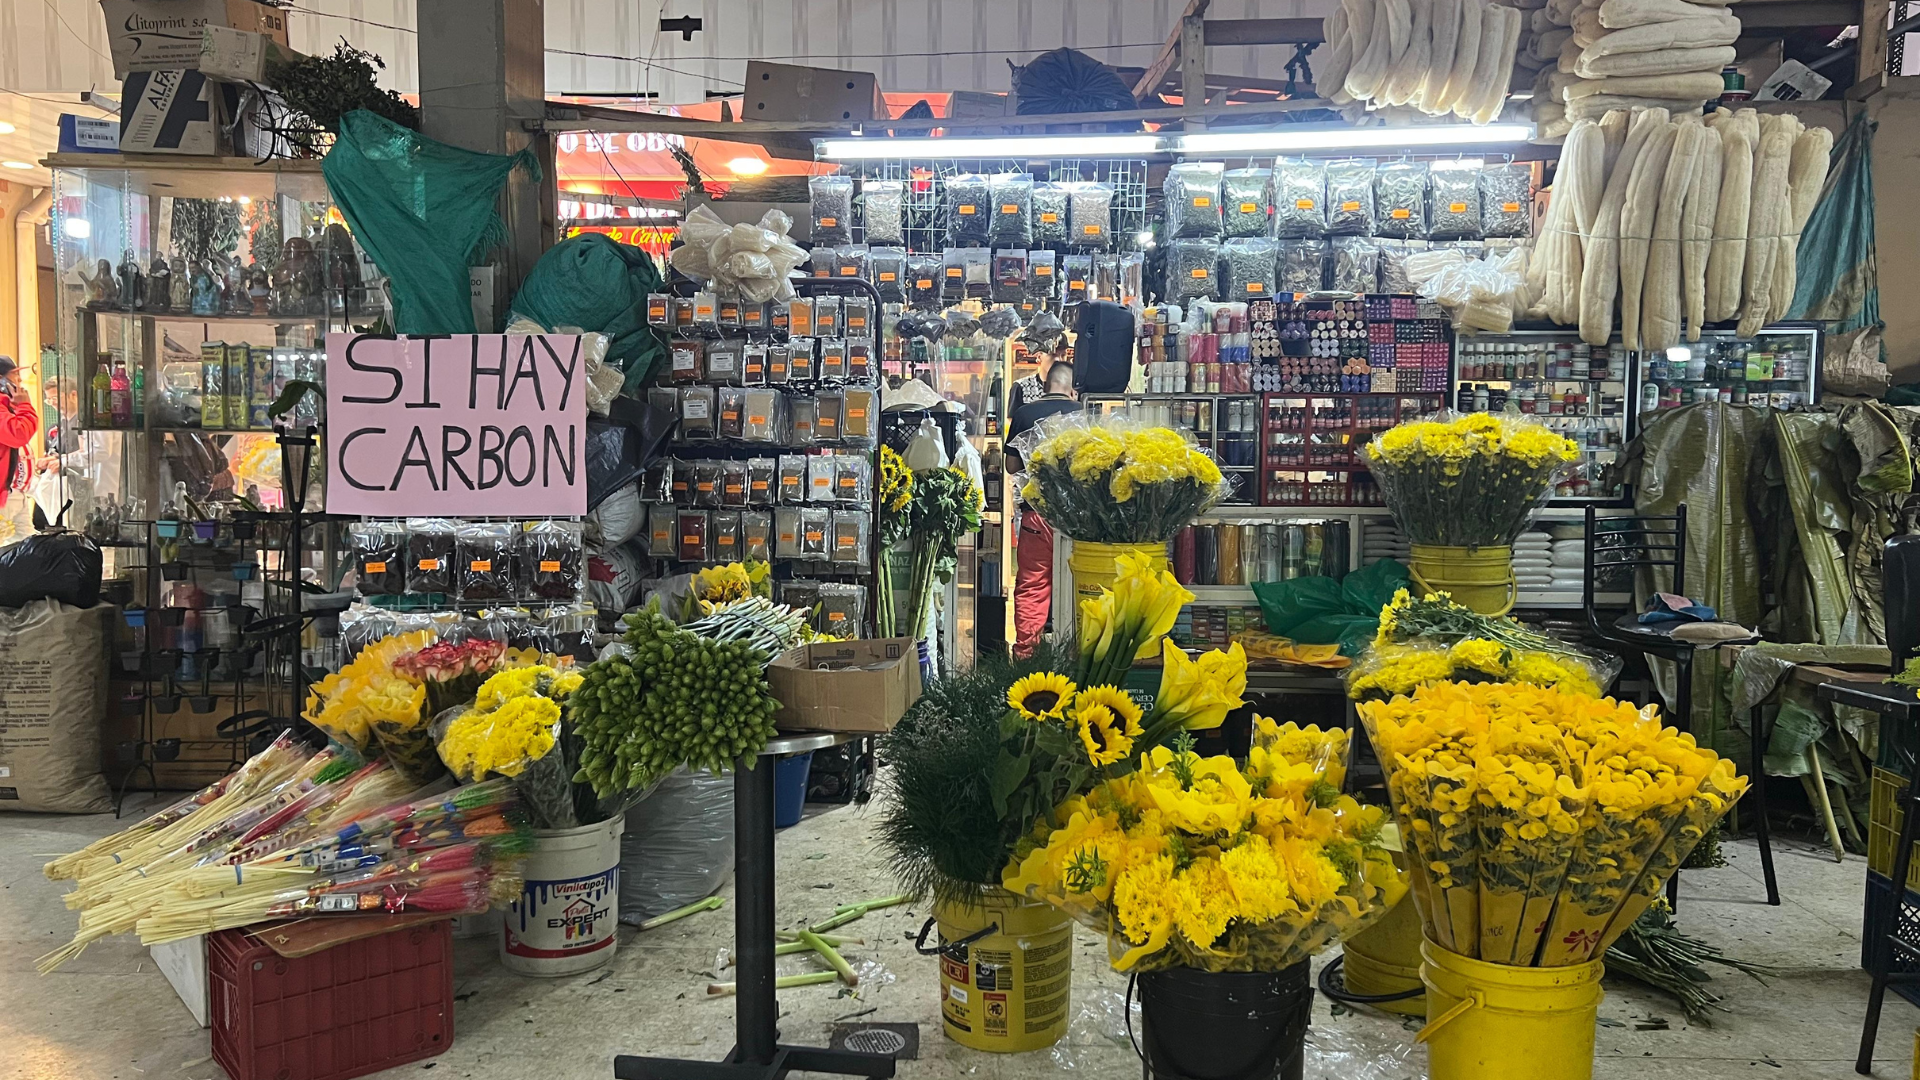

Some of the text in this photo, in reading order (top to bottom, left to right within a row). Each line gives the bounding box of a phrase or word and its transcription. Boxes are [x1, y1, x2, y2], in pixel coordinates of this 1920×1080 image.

[148, 70, 174, 110] ALFA
[341, 333, 581, 411] SI HAY
[338, 424, 576, 491] CARBON
[547, 907, 610, 929] EXPERT
